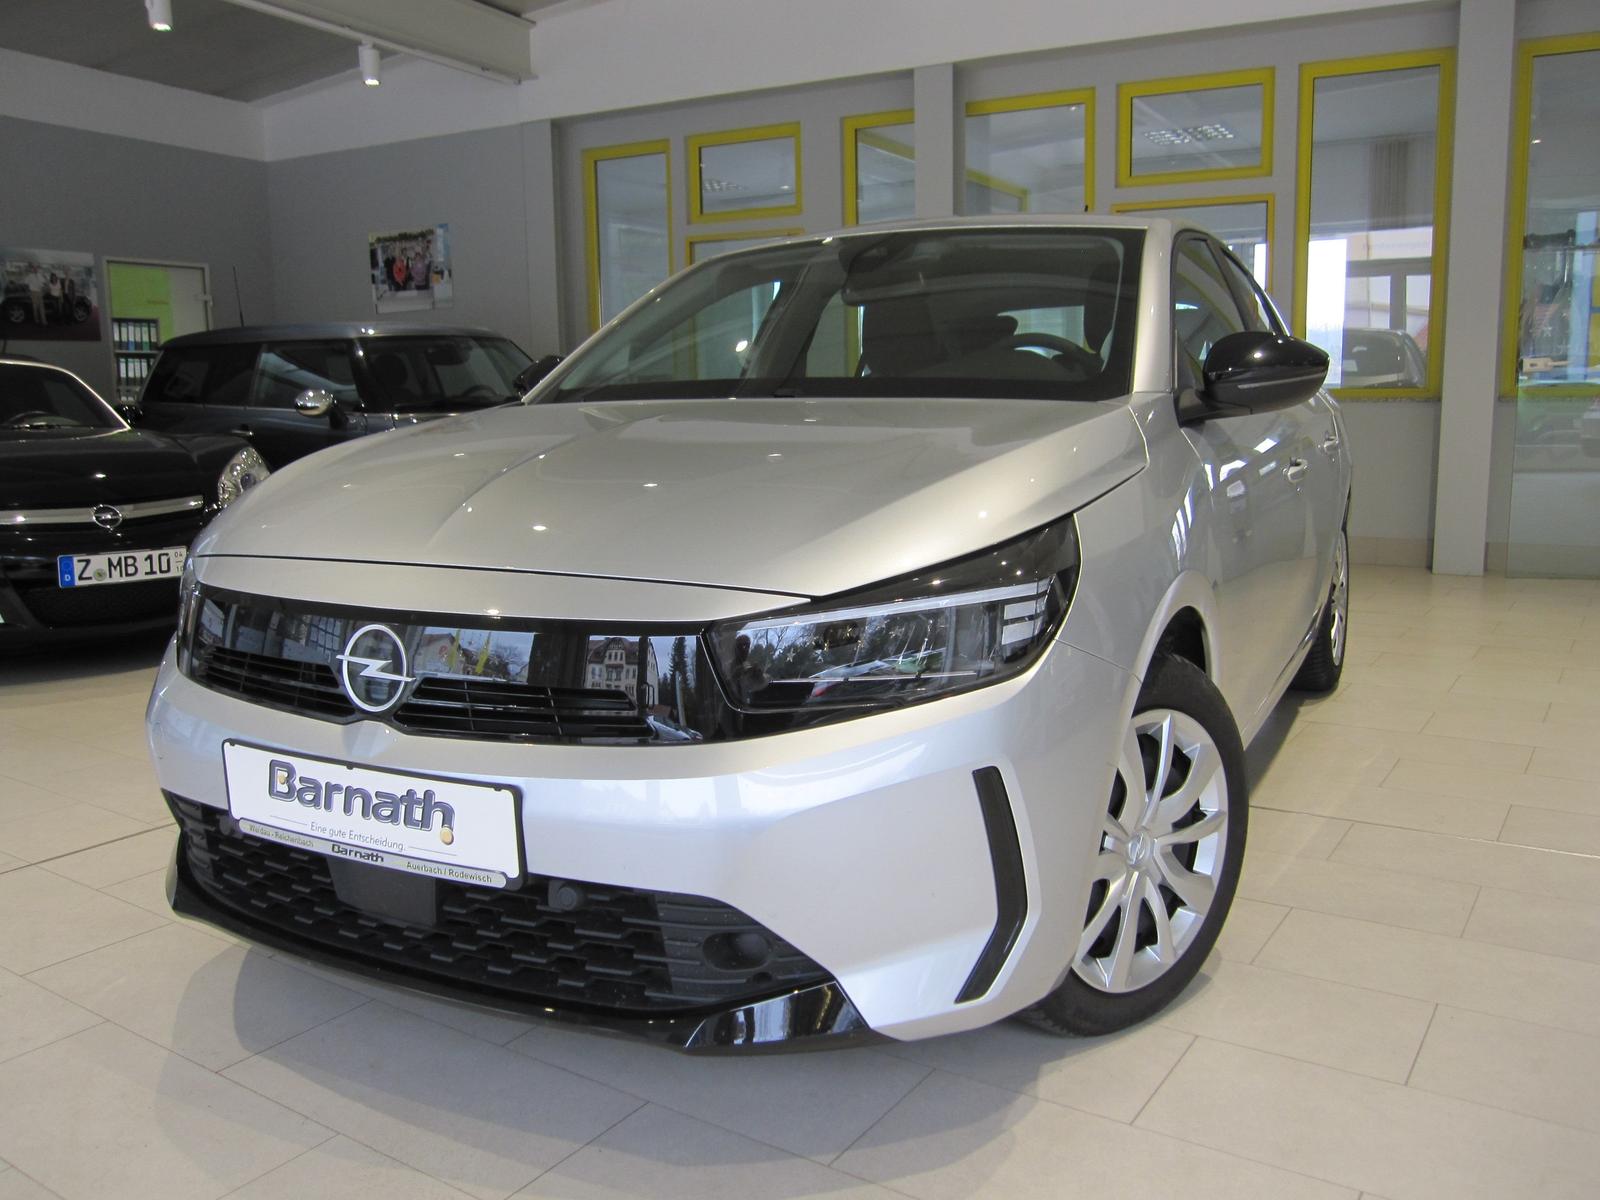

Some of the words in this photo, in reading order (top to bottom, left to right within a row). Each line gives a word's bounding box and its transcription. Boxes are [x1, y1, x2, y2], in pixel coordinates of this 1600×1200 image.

[77, 558, 92, 581] Z
[107, 556, 139, 579] MB
[144, 552, 171, 576] 10
[268, 759, 455, 844] Barnath
[310, 821, 328, 834] Eine
[328, 827, 347, 840] gute
[348, 829, 406, 852] Entscheidung.
[331, 843, 384, 863] Barnath
[406, 861, 443, 876] Auerbach
[448, 868, 492, 884] Rodewisch
